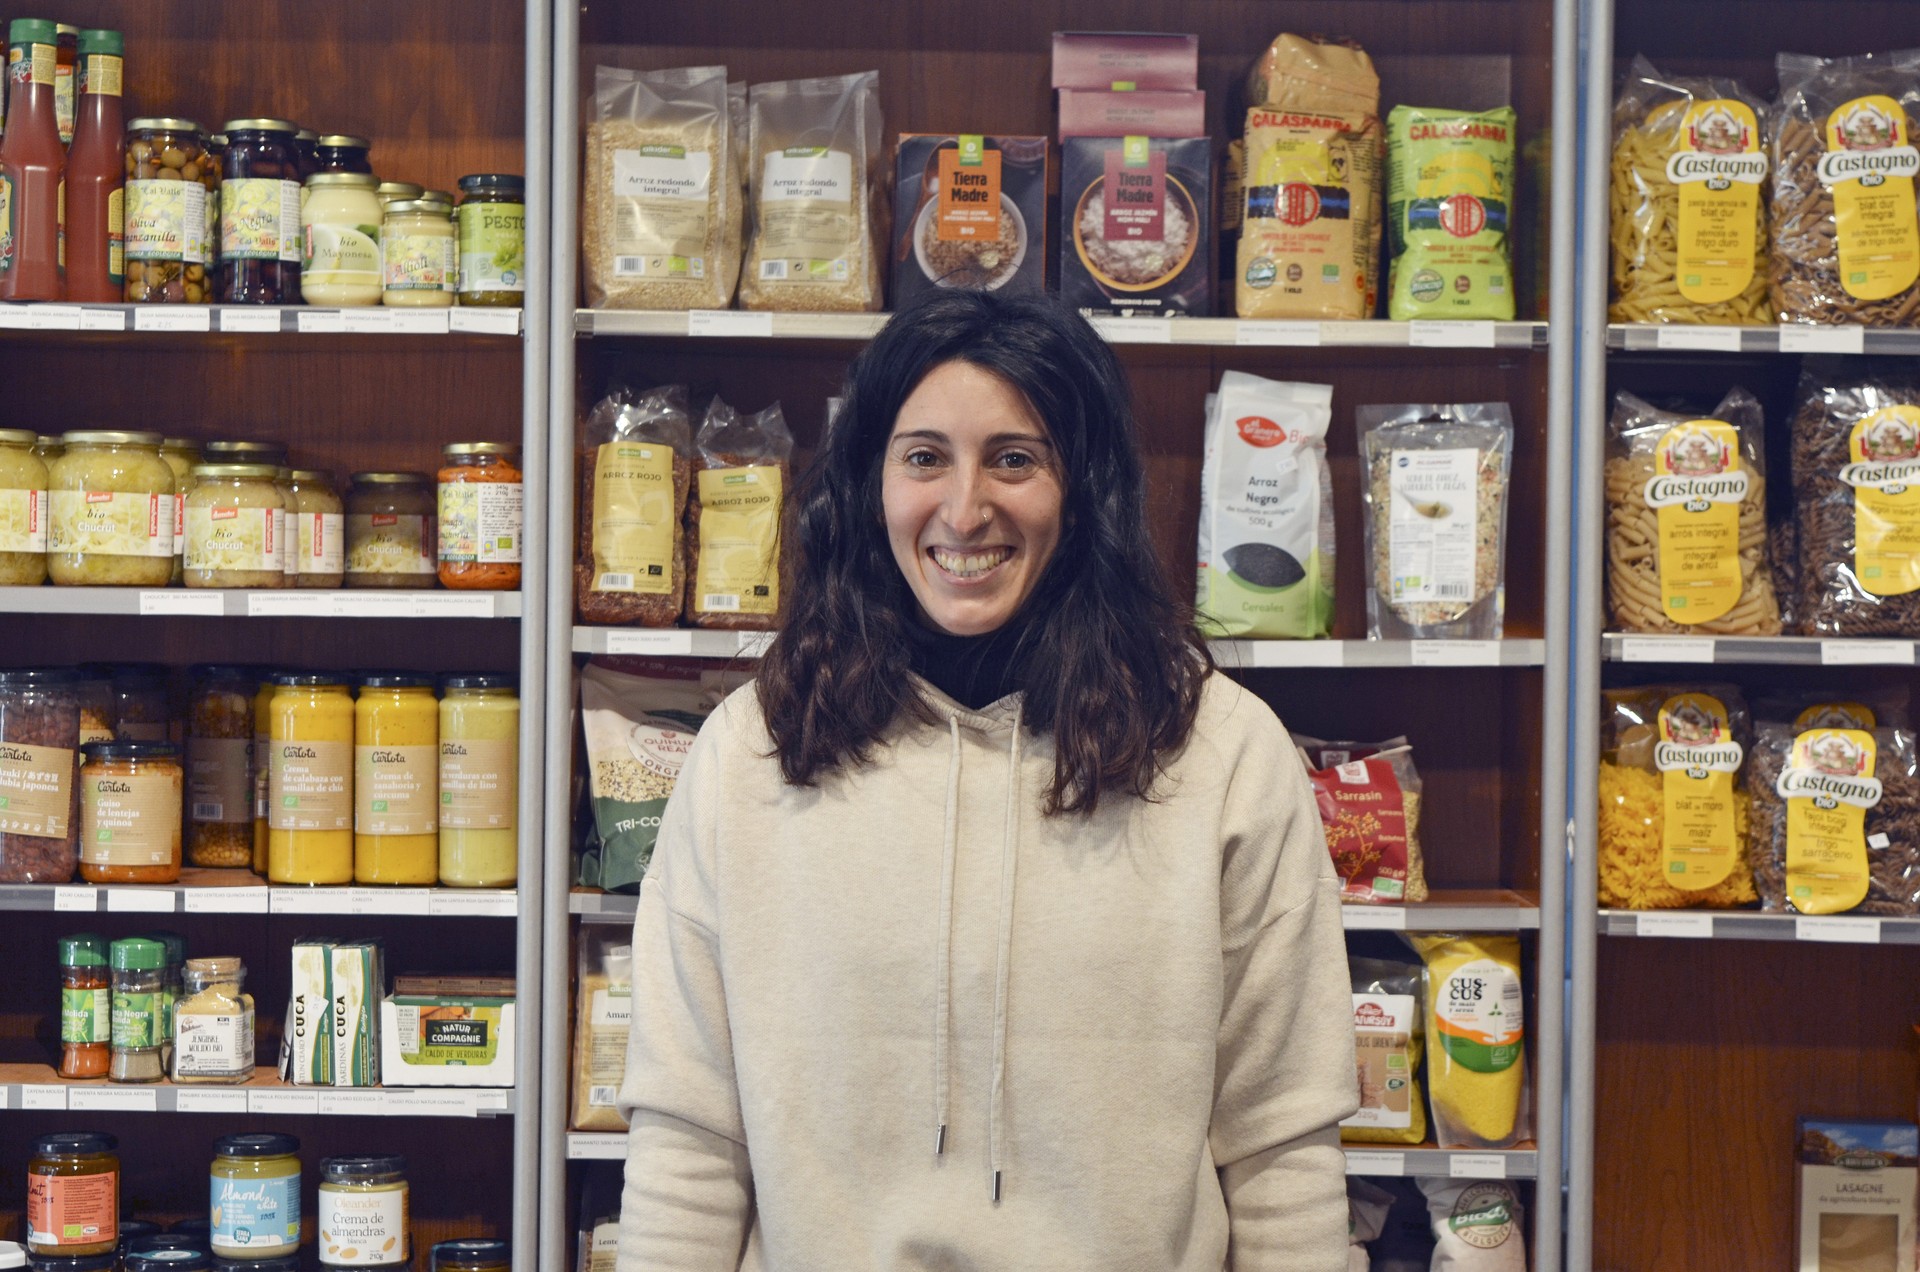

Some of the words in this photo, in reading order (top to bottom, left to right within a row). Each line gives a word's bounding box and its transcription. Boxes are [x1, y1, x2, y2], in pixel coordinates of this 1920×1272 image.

[1251, 113, 1351, 133] CALASPARRA
[1409, 124, 1507, 144] CALASPARRA
[1673, 154, 1765, 178] Castagno
[1824, 152, 1917, 178] Castagno
[628, 175, 656, 186] Arroz
[657, 177, 696, 188] redondo
[773, 179, 797, 188] Arroz
[953, 172, 987, 186] Tierra
[1119, 172, 1152, 186] Tierra
[644, 186, 680, 196] integral
[786, 188, 823, 197] integral
[951, 188, 988, 202] Madre
[1117, 189, 1153, 203] Madre
[338, 235, 358, 247] bio
[321, 247, 374, 262] Mayonesa
[602, 471, 635, 481] ARROZ
[636, 472, 662, 482] ROJO
[1846, 464, 1920, 482] Castag
[1248, 476, 1279, 487] Arroz
[1649, 477, 1746, 502] Castagno
[711, 497, 743, 507] ARROZ
[744, 495, 771, 505] ROJO
[1246, 492, 1279, 506] Negro
[87, 508, 106, 519] bio
[78, 522, 115, 533] Chucrut
[215, 527, 233, 538] bio
[376, 532, 393, 543] bio
[206, 540, 243, 550] Chucrut
[367, 545, 403, 555] Chucrut
[1241, 601, 1284, 614] Cereales
[283, 746, 317, 760] Carlota
[441, 743, 468, 756] Carlota
[657, 744, 688, 754] REAL
[371, 751, 406, 764] Carlota
[1657, 744, 1739, 768] Castagno
[282, 764, 309, 774] Crema
[644, 759, 680, 778] ORGA
[282, 774, 292, 783] de
[293, 774, 329, 783] calabaza
[330, 775, 344, 783] con
[372, 770, 401, 781] Crema
[403, 770, 414, 780] de
[482, 771, 498, 780] con
[0, 776, 21, 788] lubia
[97, 781, 131, 793] Carlota
[282, 783, 318, 793] semillas
[319, 783, 327, 792] de
[372, 780, 415, 790] zanahoria
[467, 780, 478, 789] de
[479, 780, 498, 789] lino
[1782, 770, 1878, 800] Castagno
[1335, 789, 1383, 802] Sarrasin
[97, 798, 121, 808] Guiso
[97, 809, 106, 818] de
[107, 808, 140, 820] lentejas
[102, 818, 132, 828] quinoa
[616, 816, 661, 834] TRI-CO
[1449, 977, 1487, 990] CUS-
[1449, 989, 1483, 1001] CUS
[123, 1009, 149, 1019] Negra
[295, 993, 305, 1038] CUCA
[336, 993, 346, 1038] CUCA
[442, 1023, 471, 1034] NATUR
[431, 1033, 481, 1043] COMPAGNIE
[425, 1050, 444, 1059] CALDO
[446, 1050, 455, 1059] DE
[456, 1050, 488, 1059] VERDURAS
[339, 1040, 347, 1084] SARDINAS
[219, 1182, 265, 1202] Almond
[1836, 1183, 1884, 1193] LASAGNE
[334, 1196, 382, 1209] Oleander
[332, 1212, 368, 1224] Crema
[370, 1211, 384, 1224] de
[331, 1225, 386, 1237] almendras
